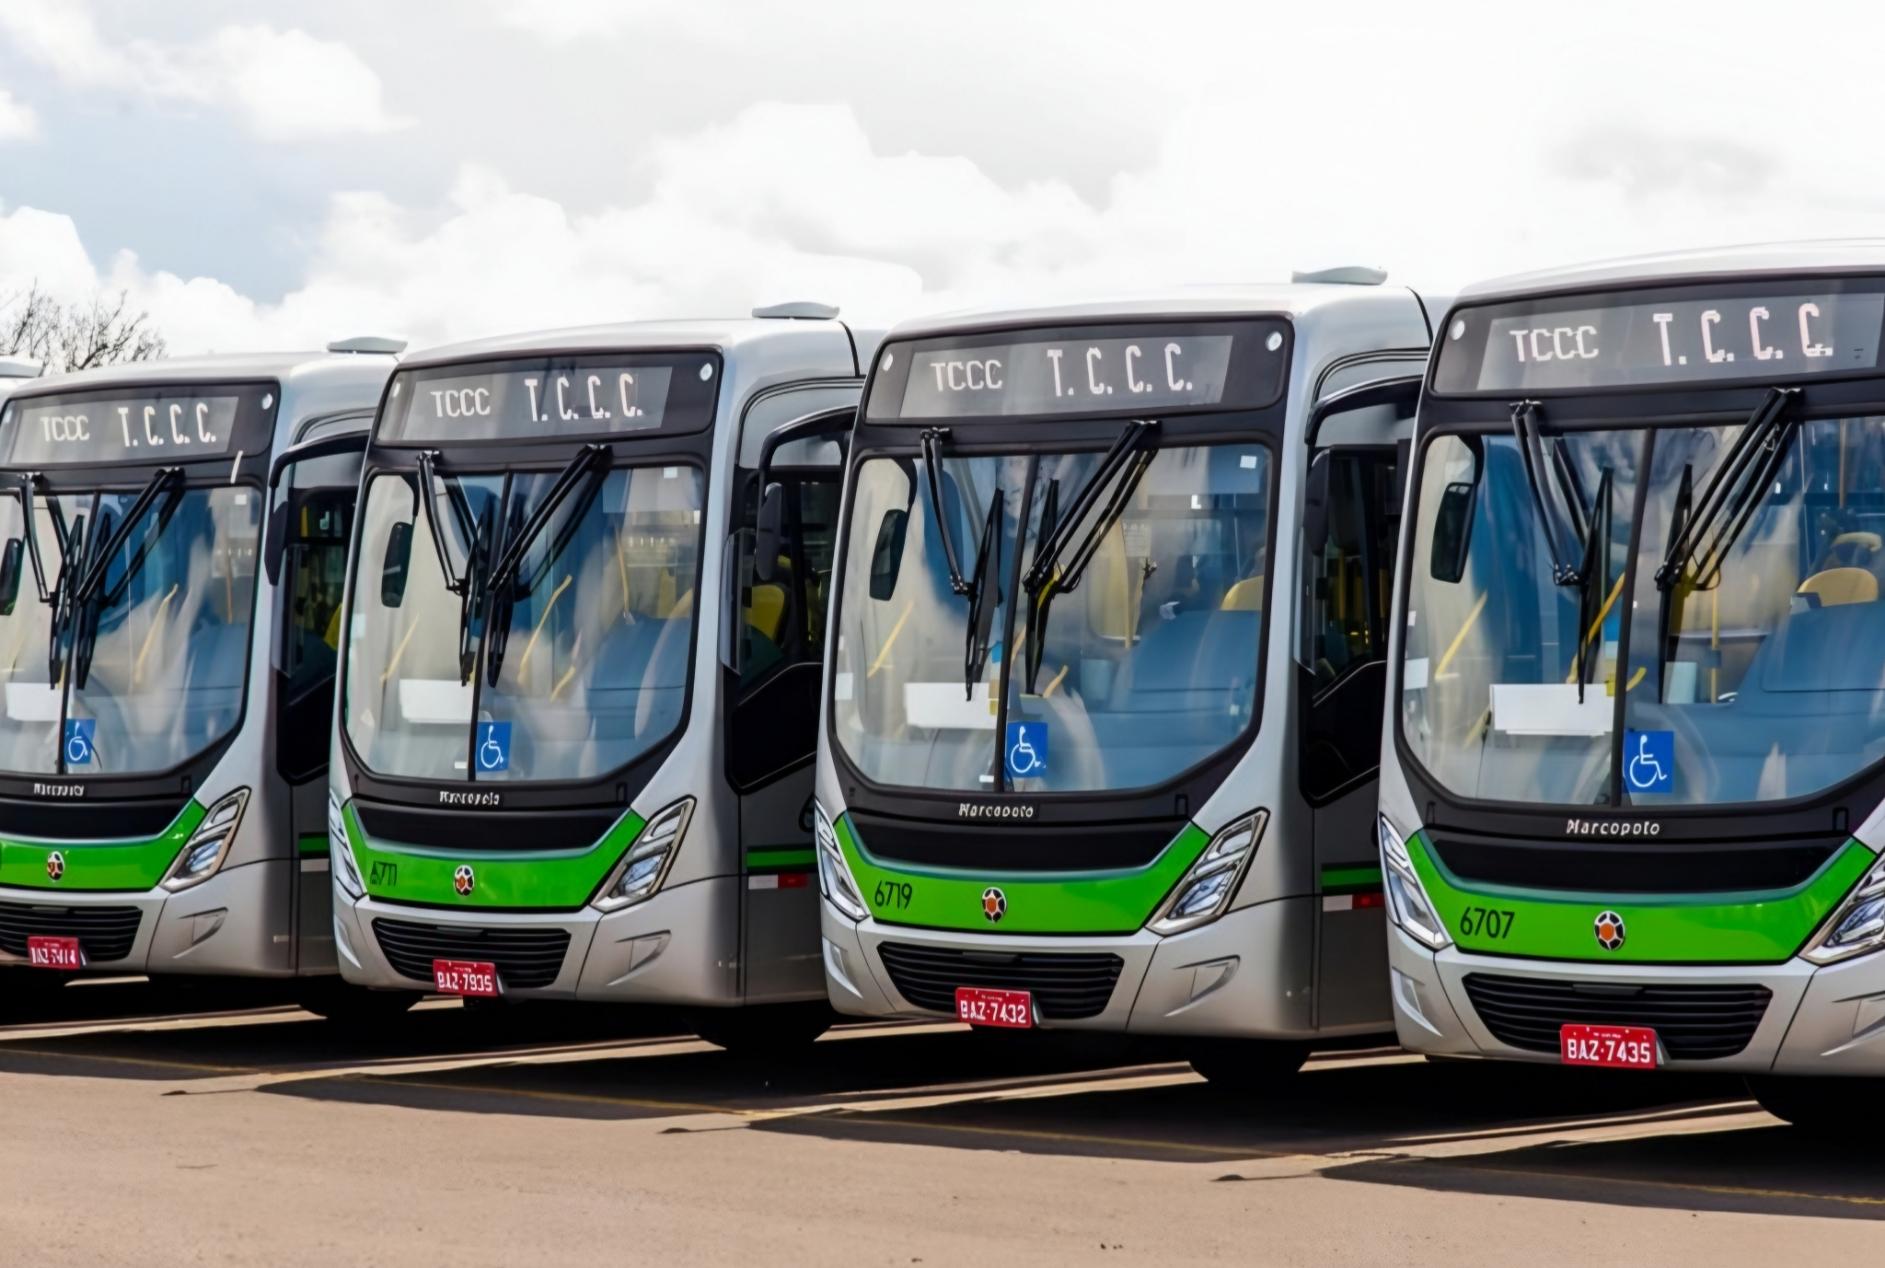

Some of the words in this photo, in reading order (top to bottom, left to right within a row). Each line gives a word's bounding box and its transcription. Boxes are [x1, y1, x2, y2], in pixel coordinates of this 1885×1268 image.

[1509, 325, 1599, 362] TCCC
[930, 359, 1003, 392] TCCC
[430, 387, 491, 418] TCCC
[40, 415, 90, 442] TCCC
[1566, 819, 1660, 836] Marcopolo
[874, 880, 913, 909] 6719
[1460, 906, 1515, 939] 6707
